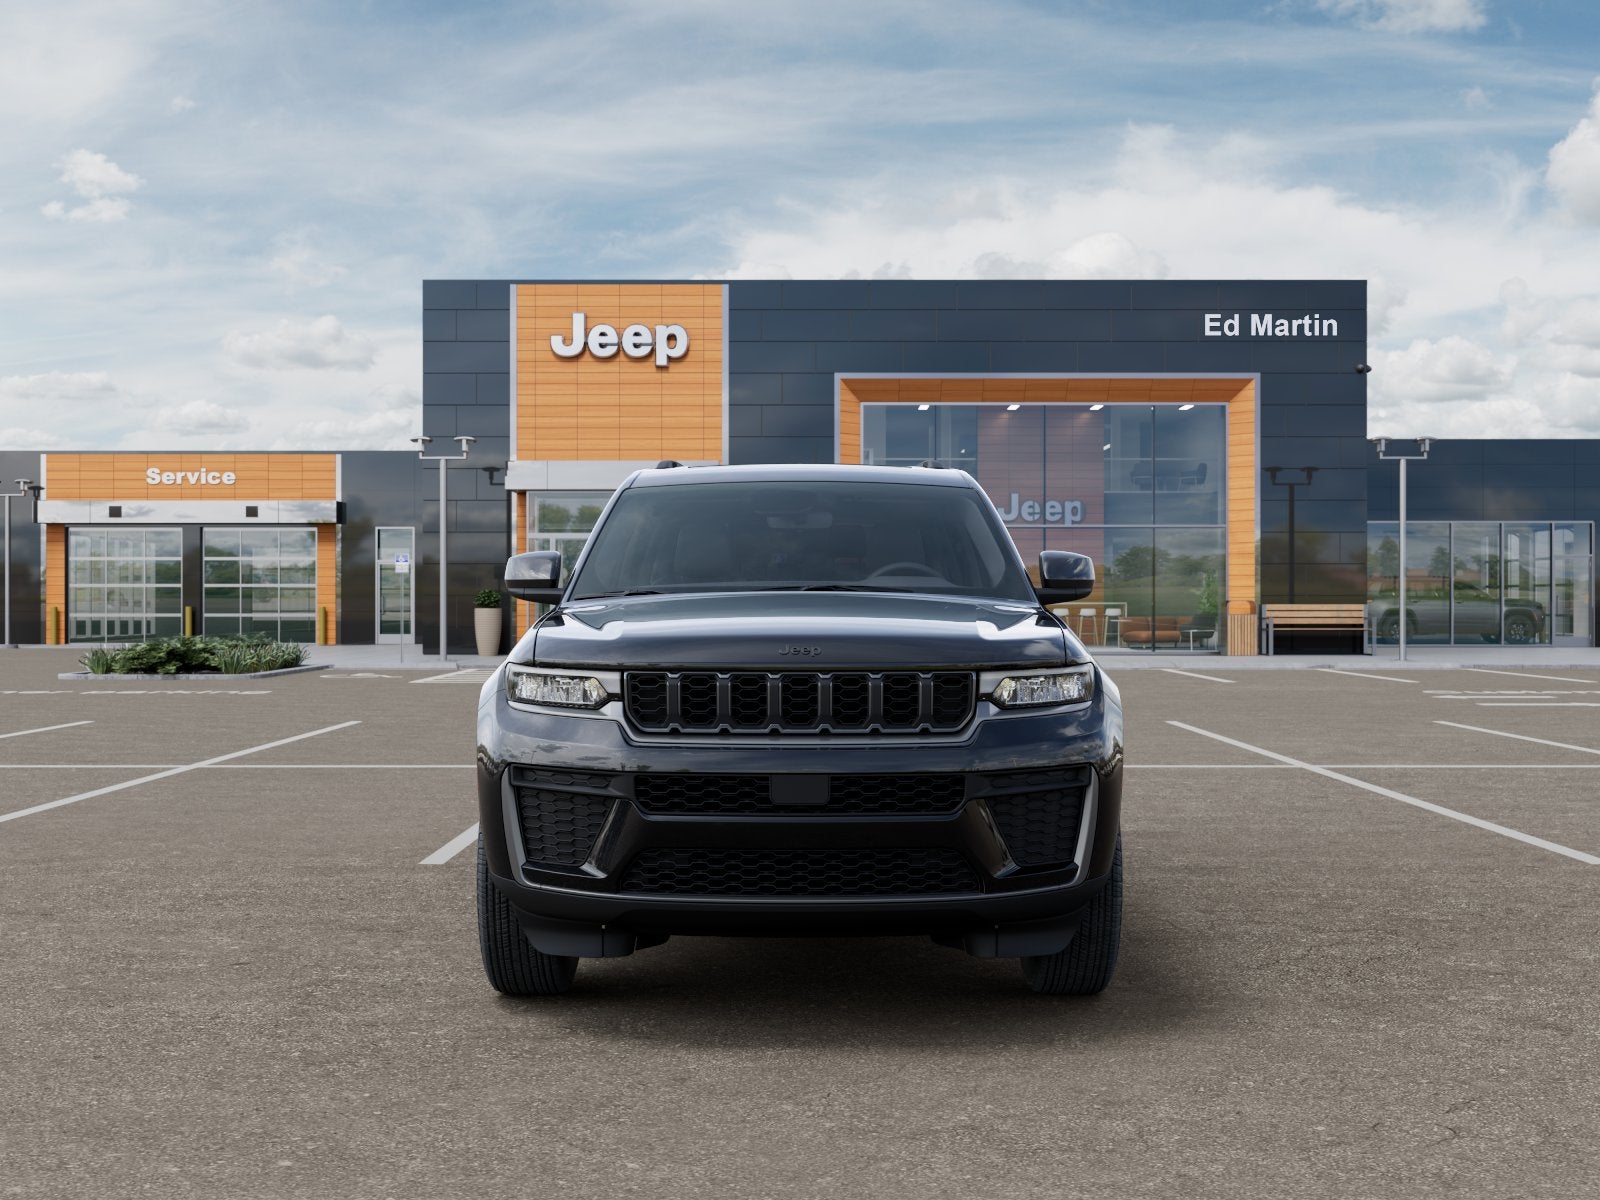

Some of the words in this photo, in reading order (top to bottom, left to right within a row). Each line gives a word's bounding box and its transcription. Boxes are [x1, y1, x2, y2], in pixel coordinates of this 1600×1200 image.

[1204, 313, 1240, 337] Ed
[1250, 313, 1338, 337] Martin
[550, 312, 689, 367] Jeep
[146, 467, 236, 486] Service
[997, 493, 1083, 527] Jeep
[778, 643, 822, 657] Jeep
